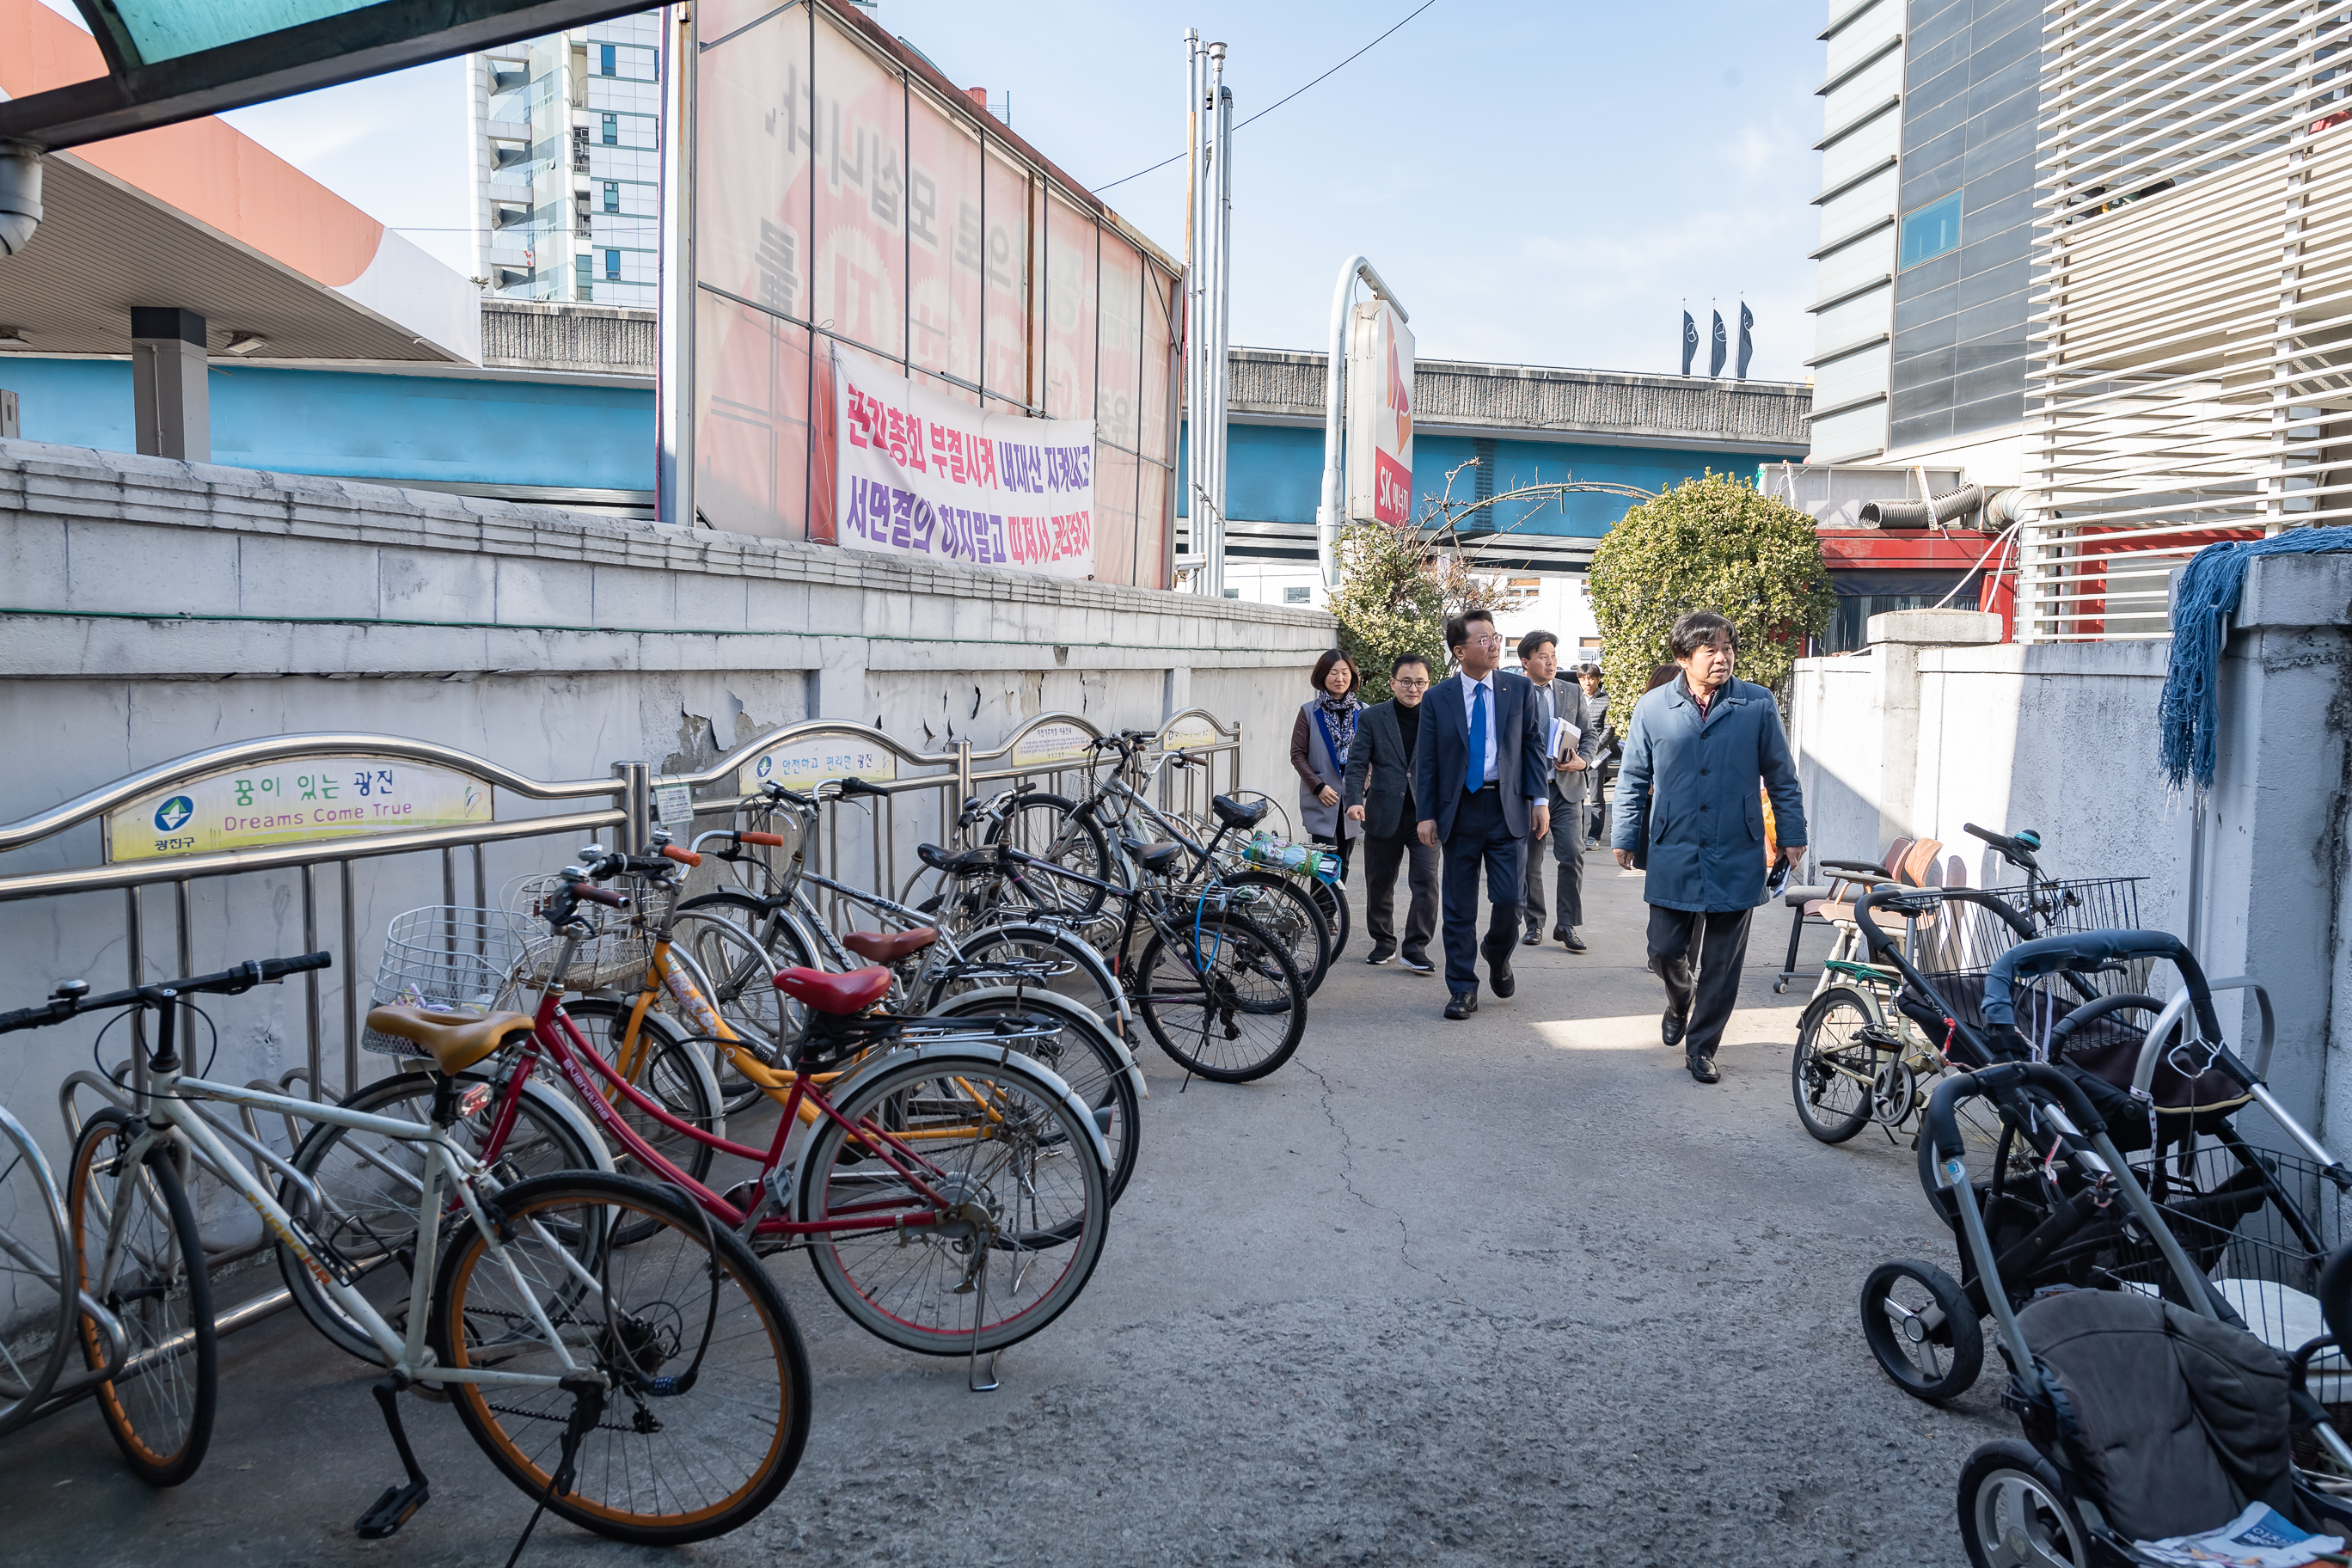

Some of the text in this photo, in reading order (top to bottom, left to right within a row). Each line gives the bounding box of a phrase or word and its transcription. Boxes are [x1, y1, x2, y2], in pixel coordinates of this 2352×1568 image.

[930, 422, 997, 490] 부결시켜
[999, 441, 1044, 493] 내재산
[1044, 445, 1091, 493] 지켜내고
[1380, 465, 1409, 521] SK 에너지
[847, 475, 937, 554] 서면결의
[938, 505, 1007, 564] 하지말고
[1008, 516, 1051, 566] 따져서
[782, 753, 873, 775] 안전하고 편리한 광진
[234, 769, 394, 806] 꿈이 있는 광진
[225, 801, 413, 831] Dreams Come True
[154, 836, 195, 851] 광진구
[563, 1058, 609, 1121] everytime
